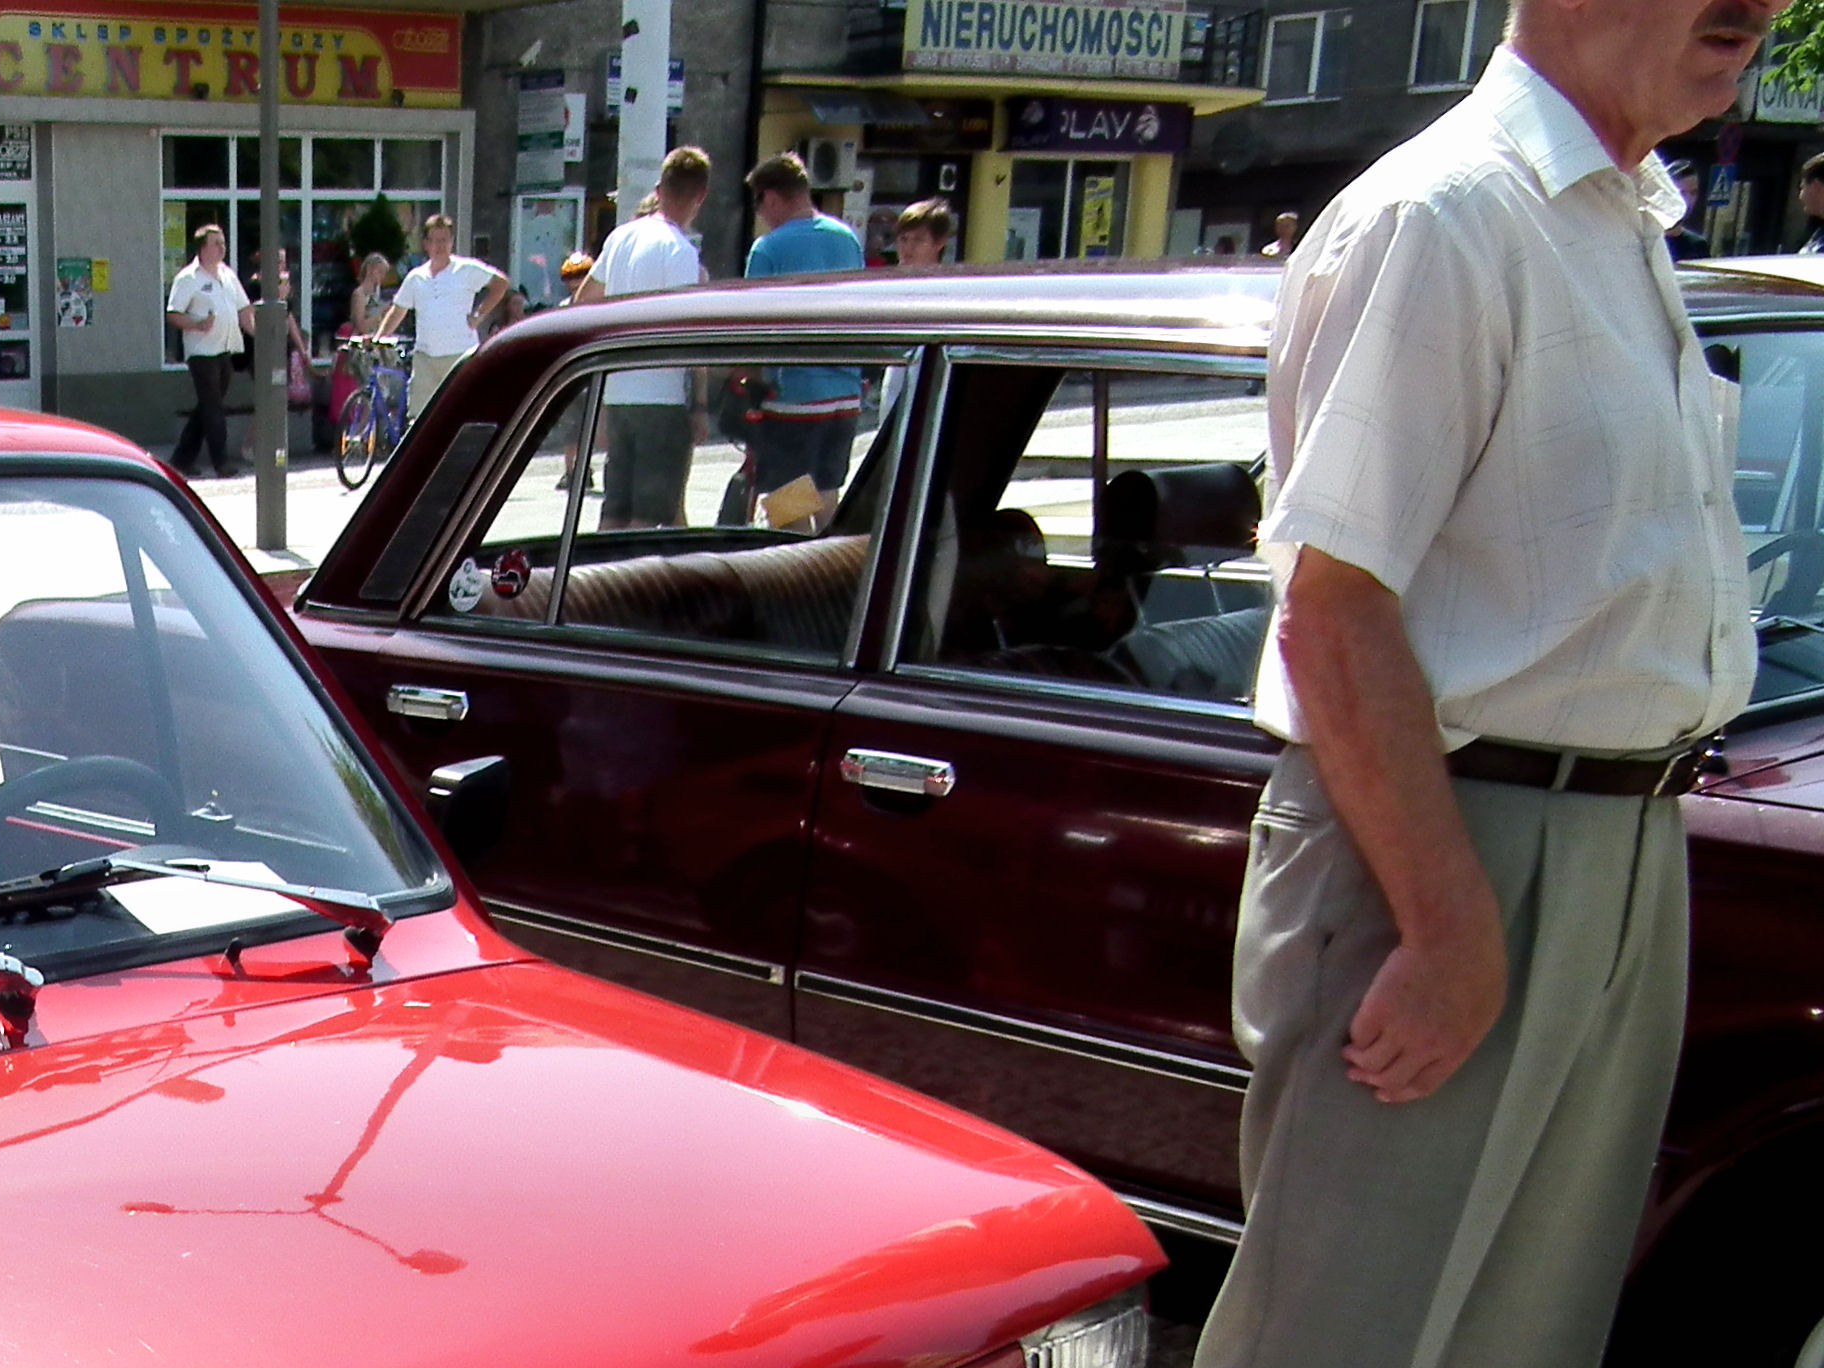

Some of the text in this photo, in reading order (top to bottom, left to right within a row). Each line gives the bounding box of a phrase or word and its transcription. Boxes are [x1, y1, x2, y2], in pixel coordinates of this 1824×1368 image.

[28, 21, 344, 50] SKLEP SPOŻYCZY
[920, 0, 1172, 58] NIERUCHOMOŚCI
